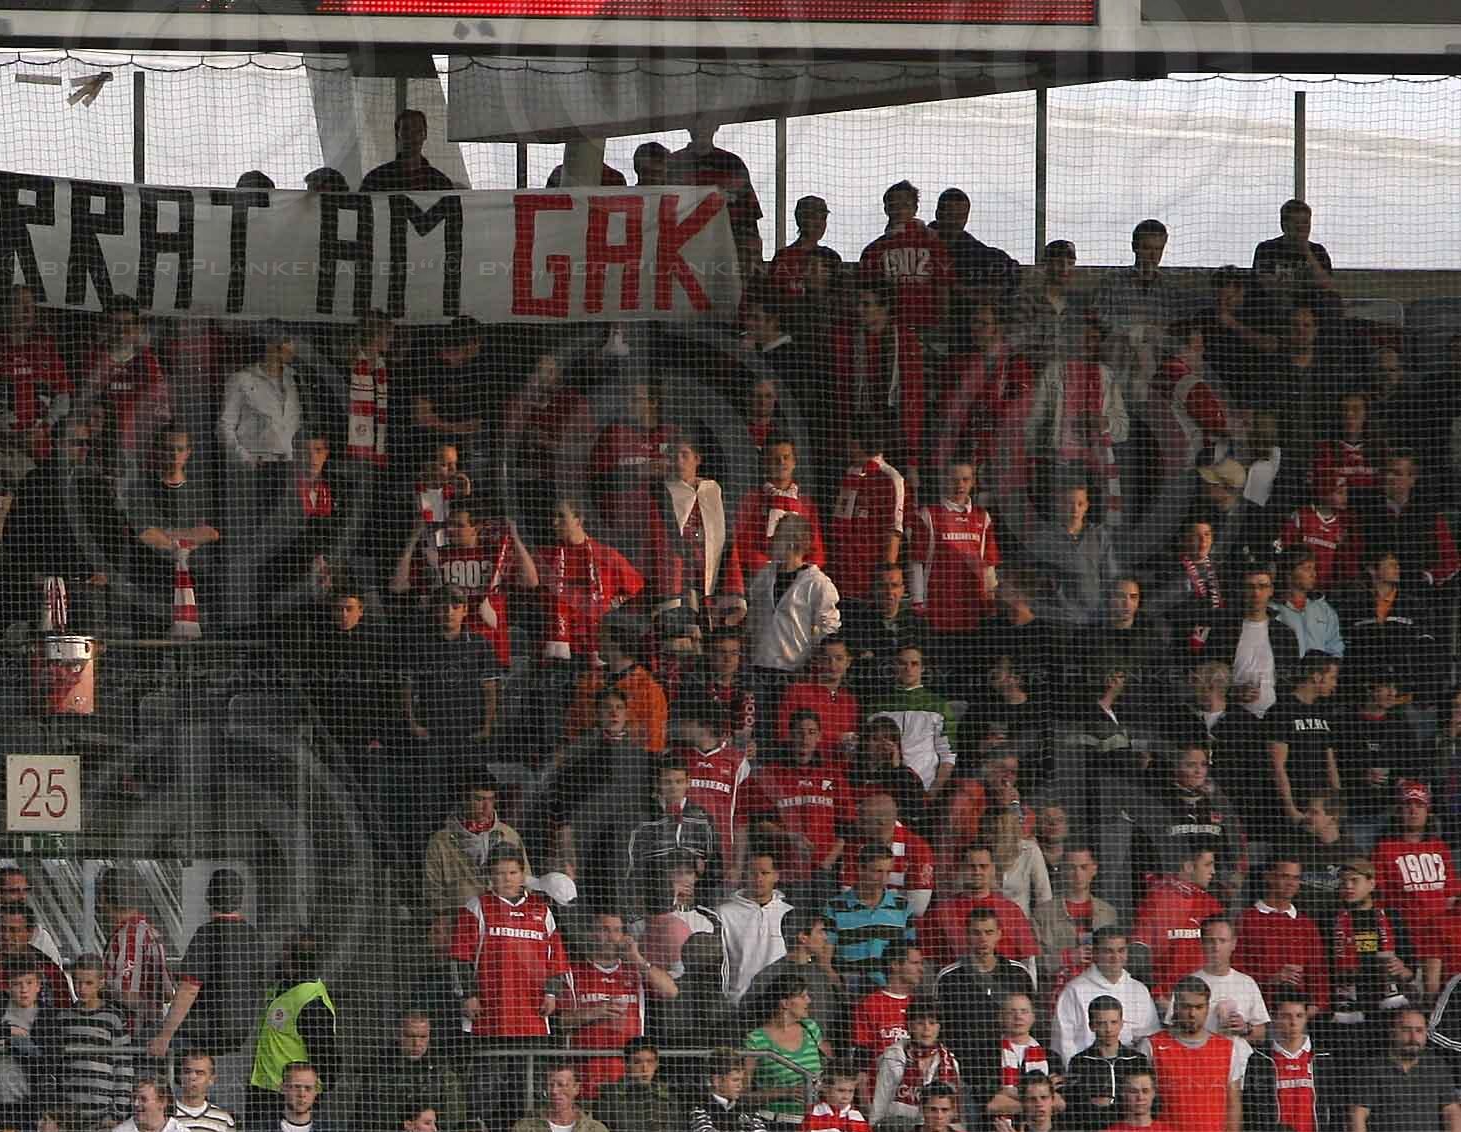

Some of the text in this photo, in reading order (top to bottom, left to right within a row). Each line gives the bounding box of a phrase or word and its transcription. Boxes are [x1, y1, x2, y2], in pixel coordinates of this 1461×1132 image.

[315, 192, 464, 318] AM
[510, 191, 727, 318] GAK
[19, 769, 69, 818] 25
[1396, 853, 1447, 884] 1902
